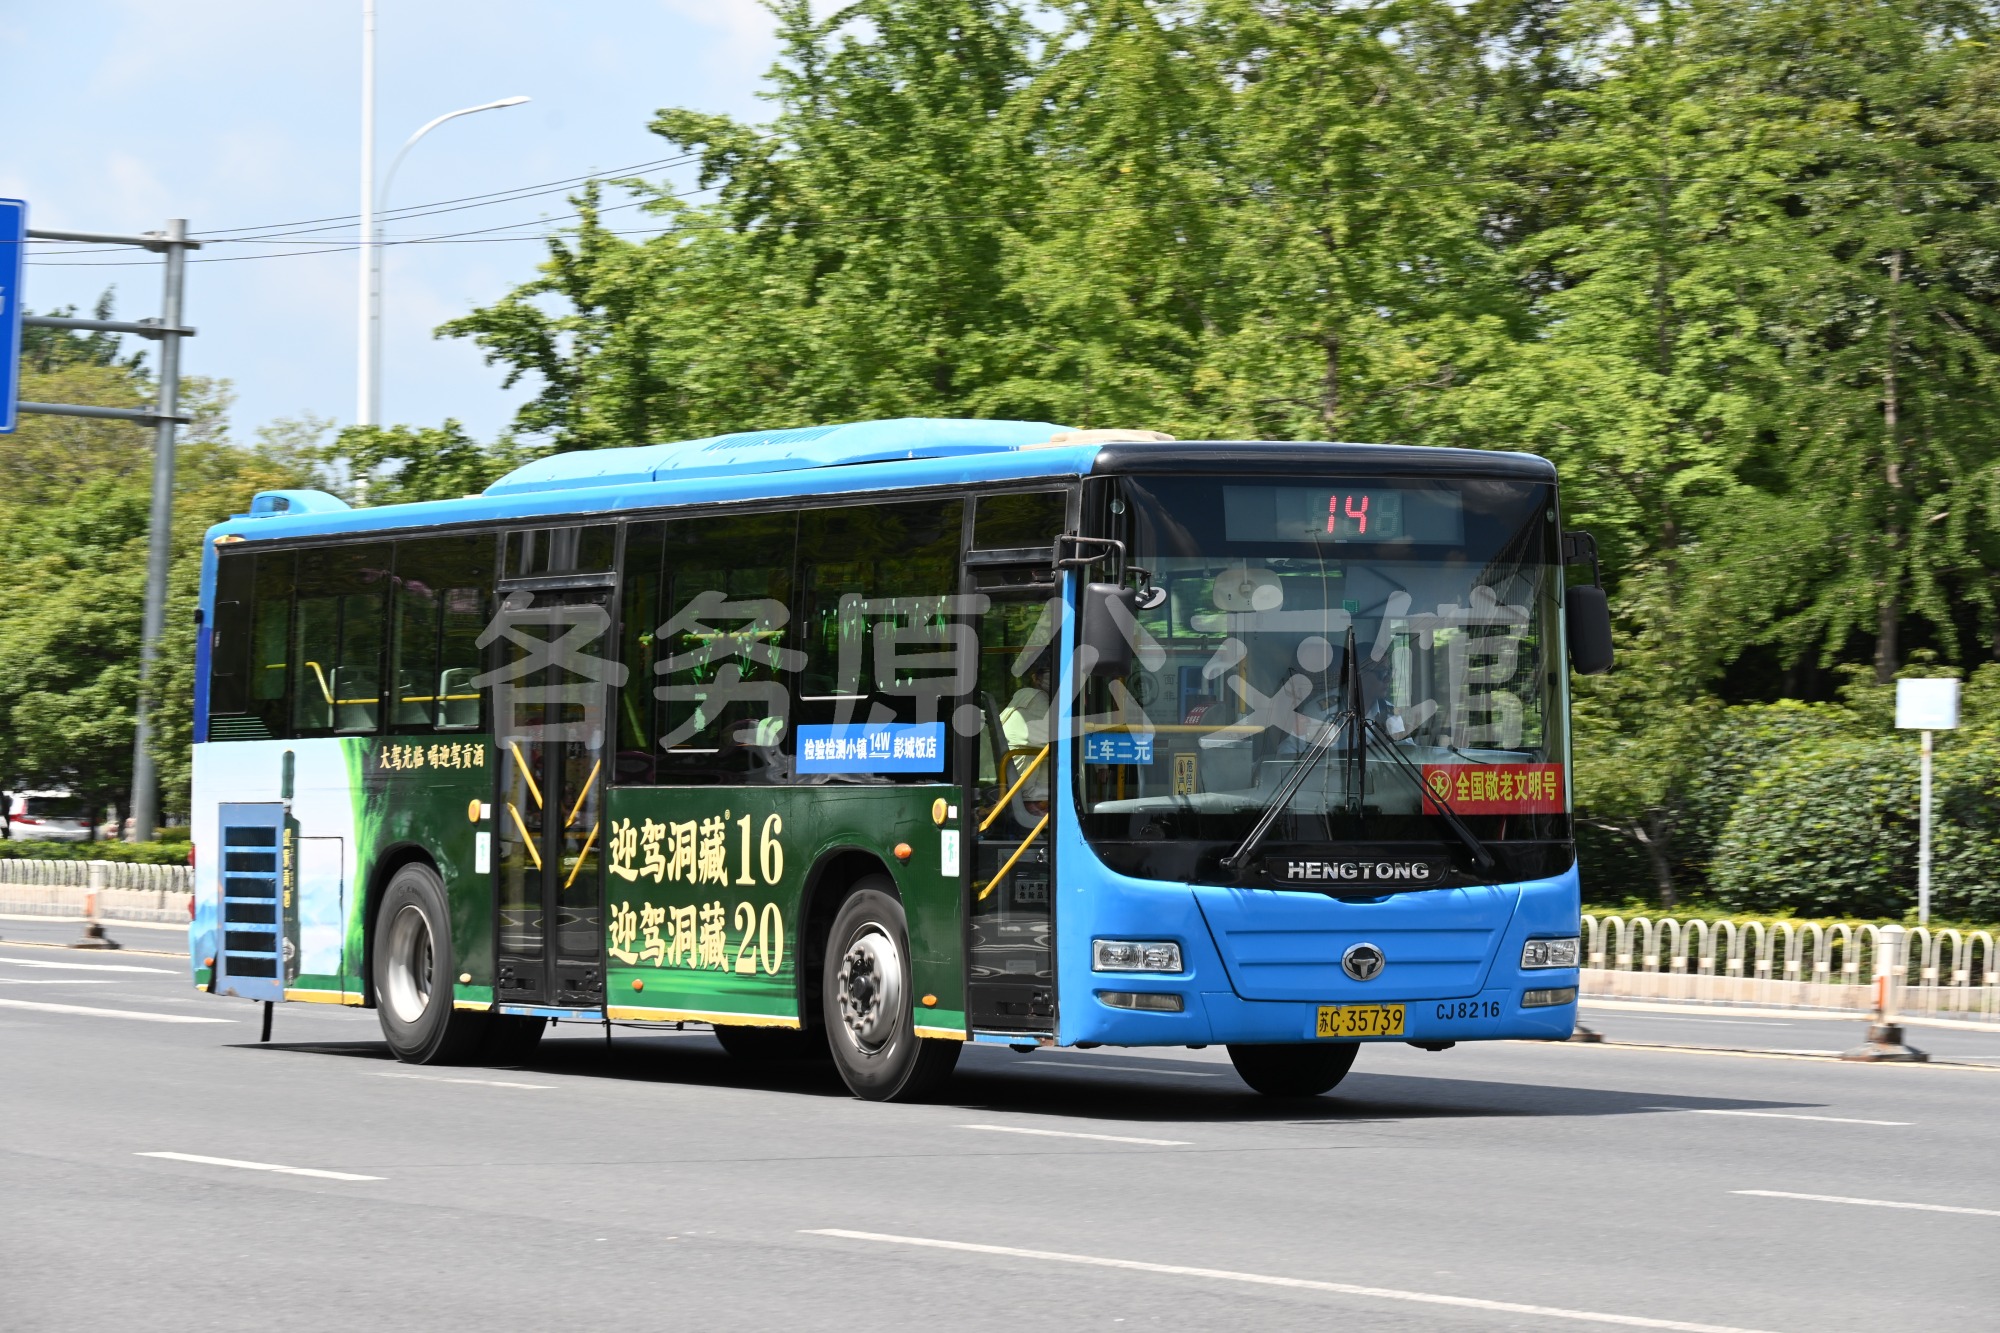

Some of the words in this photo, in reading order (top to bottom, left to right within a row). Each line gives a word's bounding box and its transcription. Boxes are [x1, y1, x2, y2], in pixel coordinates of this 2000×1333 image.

[1327, 495, 1369, 534] 14
[380, 744, 424, 771] 大驾光临
[427, 742, 485, 769] 喝迎驾贡酒
[804, 738, 867, 760] 检验检测小镇
[869, 732, 891, 751] 14W
[893, 736, 937, 759] 彭城饭店
[1084, 739, 1151, 761] 上车二元
[1456, 771, 1557, 801] 全国敬老文明号
[1287, 861, 1429, 880] HENGTONG
[1436, 1001, 1500, 1020] CJ8216
